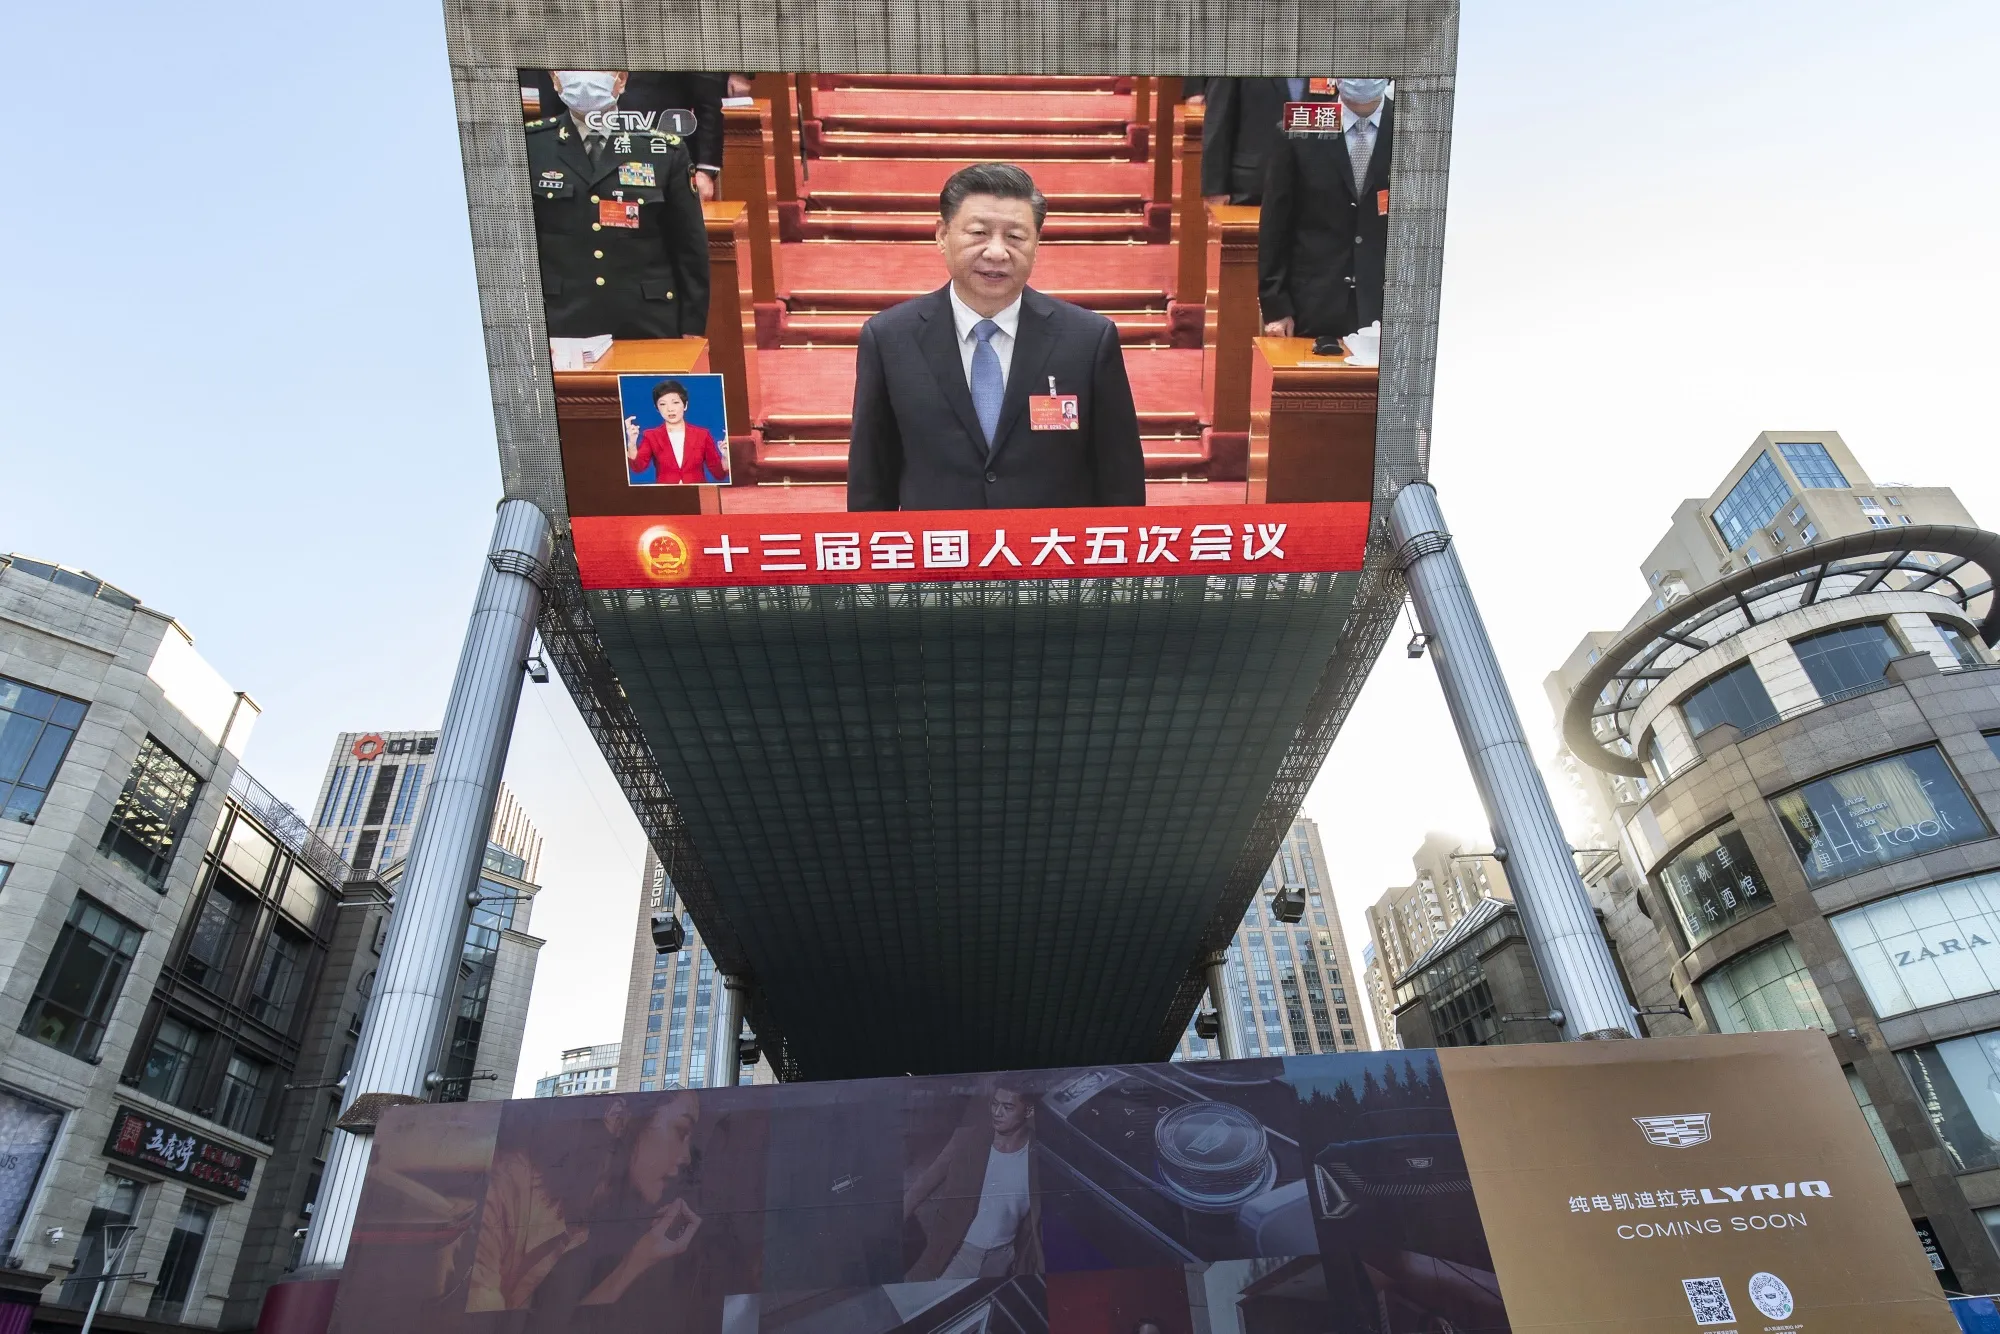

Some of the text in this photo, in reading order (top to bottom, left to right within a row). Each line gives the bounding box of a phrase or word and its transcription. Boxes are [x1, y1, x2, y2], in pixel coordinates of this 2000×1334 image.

[585, 111, 682, 132] CCTV 1
[1291, 106, 1336, 127] 直播
[614, 133, 667, 153] 综合
[703, 523, 1287, 573] 十三届全国人大五次会议
[1814, 779, 1955, 862] Hutaoli
[1686, 872, 1757, 936] 音乐酒馆
[1895, 934, 1991, 966] ZARA
[1569, 1180, 1834, 1213] 纯电凯迪拉克 LYRIQ
[1617, 1212, 1807, 1240] COMING SOON
